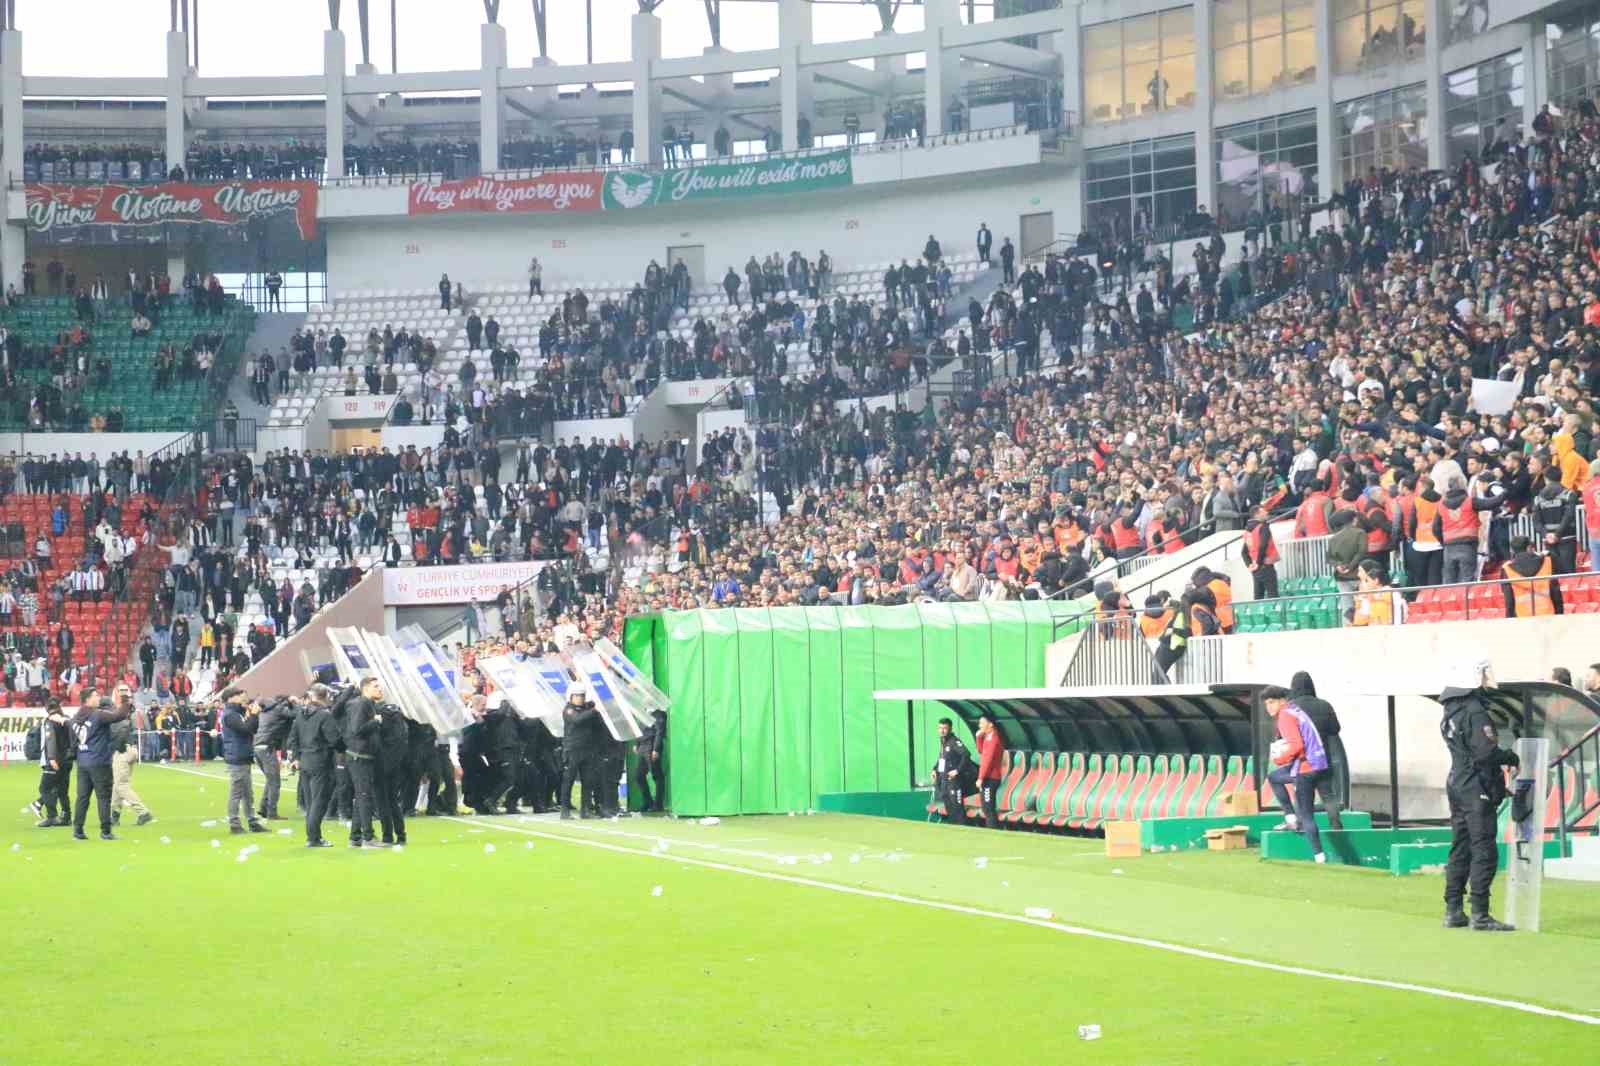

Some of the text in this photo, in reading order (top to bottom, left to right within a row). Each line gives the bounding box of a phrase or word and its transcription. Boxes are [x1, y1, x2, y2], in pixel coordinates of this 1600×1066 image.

[671, 156, 848, 200] You will exist more
[411, 180, 594, 210] They will ignore you
[29, 200, 97, 232] Yürü
[462, 583, 476, 596] VE
